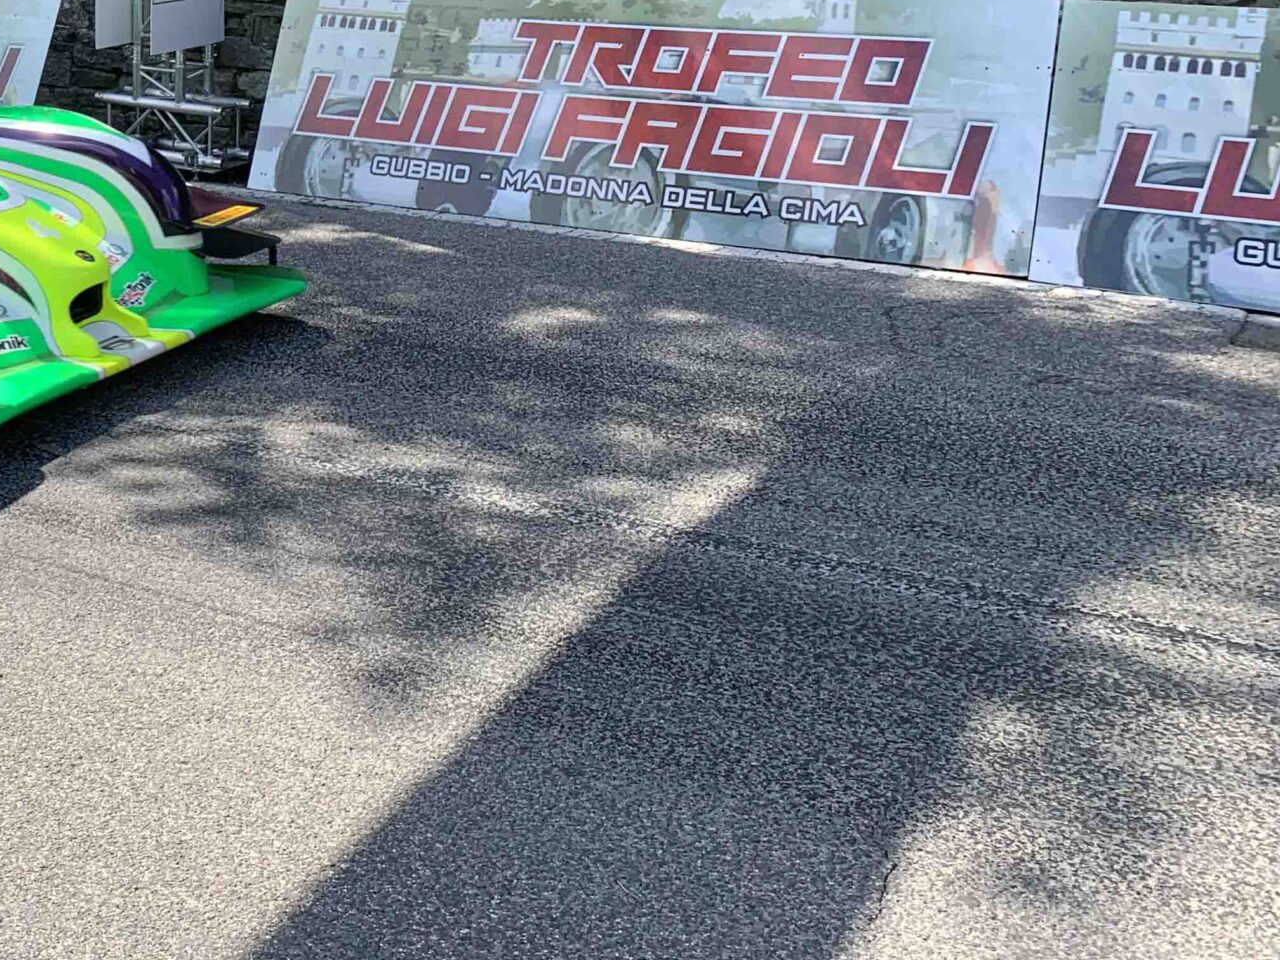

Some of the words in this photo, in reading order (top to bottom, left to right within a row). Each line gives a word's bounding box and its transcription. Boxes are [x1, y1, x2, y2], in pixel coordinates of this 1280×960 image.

[514, 18, 934, 107] TROFEO
[293, 73, 542, 157] LUIGI
[541, 93, 997, 200] FAGIOLI
[370, 154, 470, 185] GUBBIO
[500, 169, 652, 206] MADONNA
[662, 186, 771, 219] DELLA
[778, 196, 868, 227] CIMA
